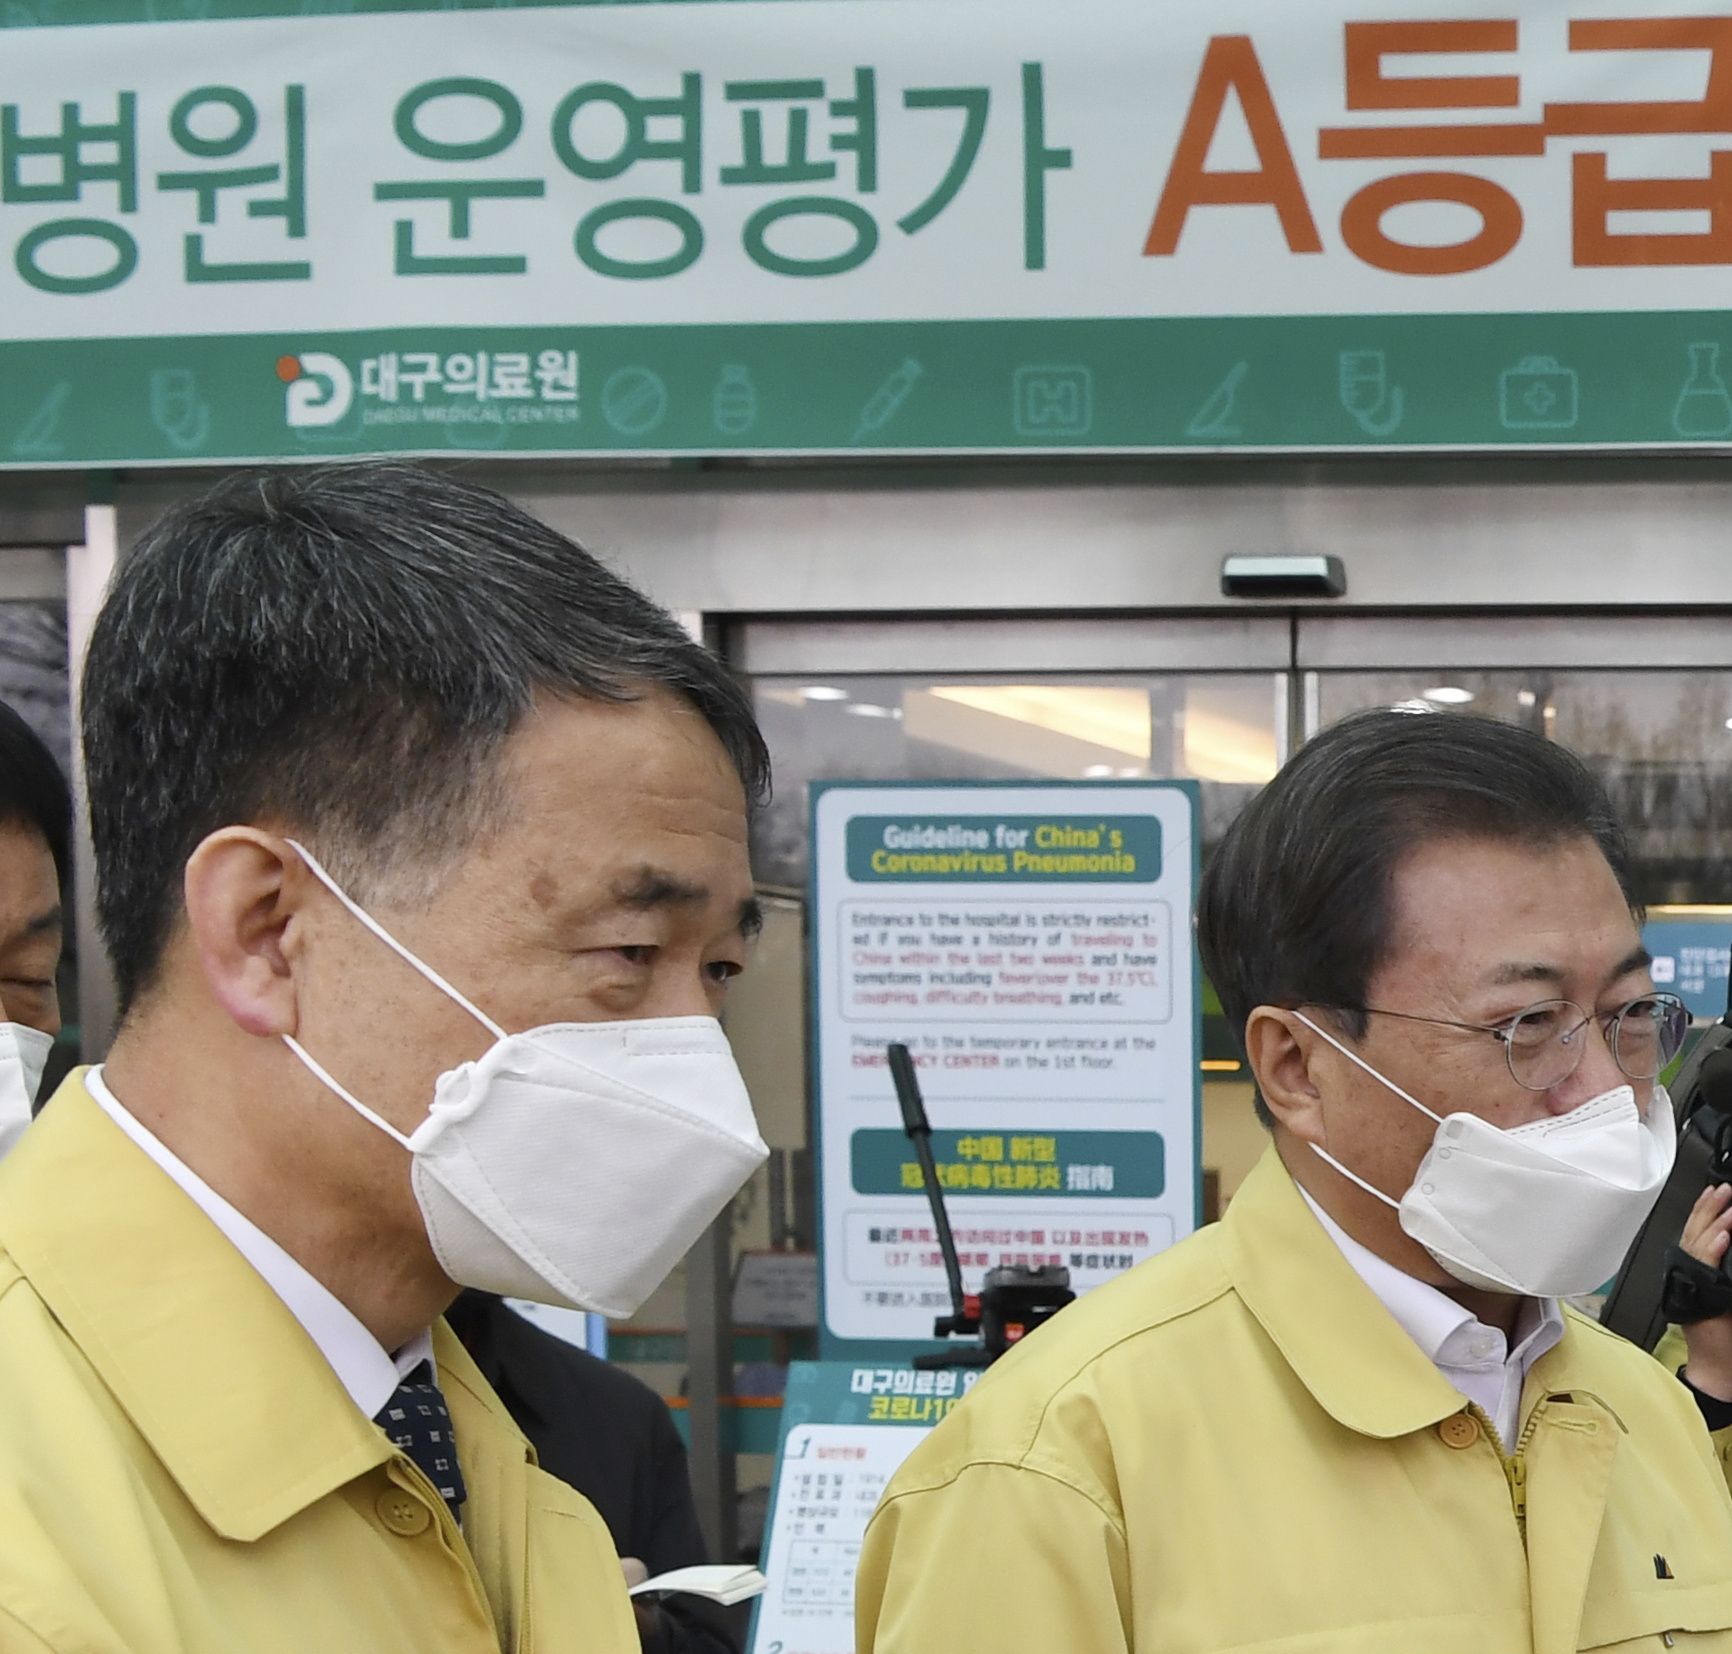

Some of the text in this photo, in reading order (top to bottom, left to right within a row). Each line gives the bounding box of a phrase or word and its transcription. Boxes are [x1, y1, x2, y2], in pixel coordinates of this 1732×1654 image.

[0, 84, 313, 296] 병원
[372, 60, 1073, 281] 운영평가
[361, 349, 580, 402] 대구의료원
[422, 406, 502, 425] MEDICAL
[506, 405, 580, 423] CENTER
[883, 825, 989, 849] Guideline
[995, 825, 1028, 848] for
[871, 850, 1136, 873] Coronavirus Pneumonia
[852, 914, 914, 927] Entrance
[919, 914, 933, 927] to
[938, 914, 959, 927] the
[965, 914, 1021, 929] hospital
[1026, 914, 1036, 927] is
[1042, 914, 1091, 929] strictly
[930, 933, 964, 946] have
[988, 933, 1038, 948] history
[1048, 933, 1062, 946] of
[1091, 953, 1117, 966] and
[1124, 953, 1158, 966] have
[929, 972, 992, 987] including
[1069, 993, 1095, 1005] and
[944, 1055, 1000, 1069] CENTER
[851, 1368, 957, 1396] 대구의료원
